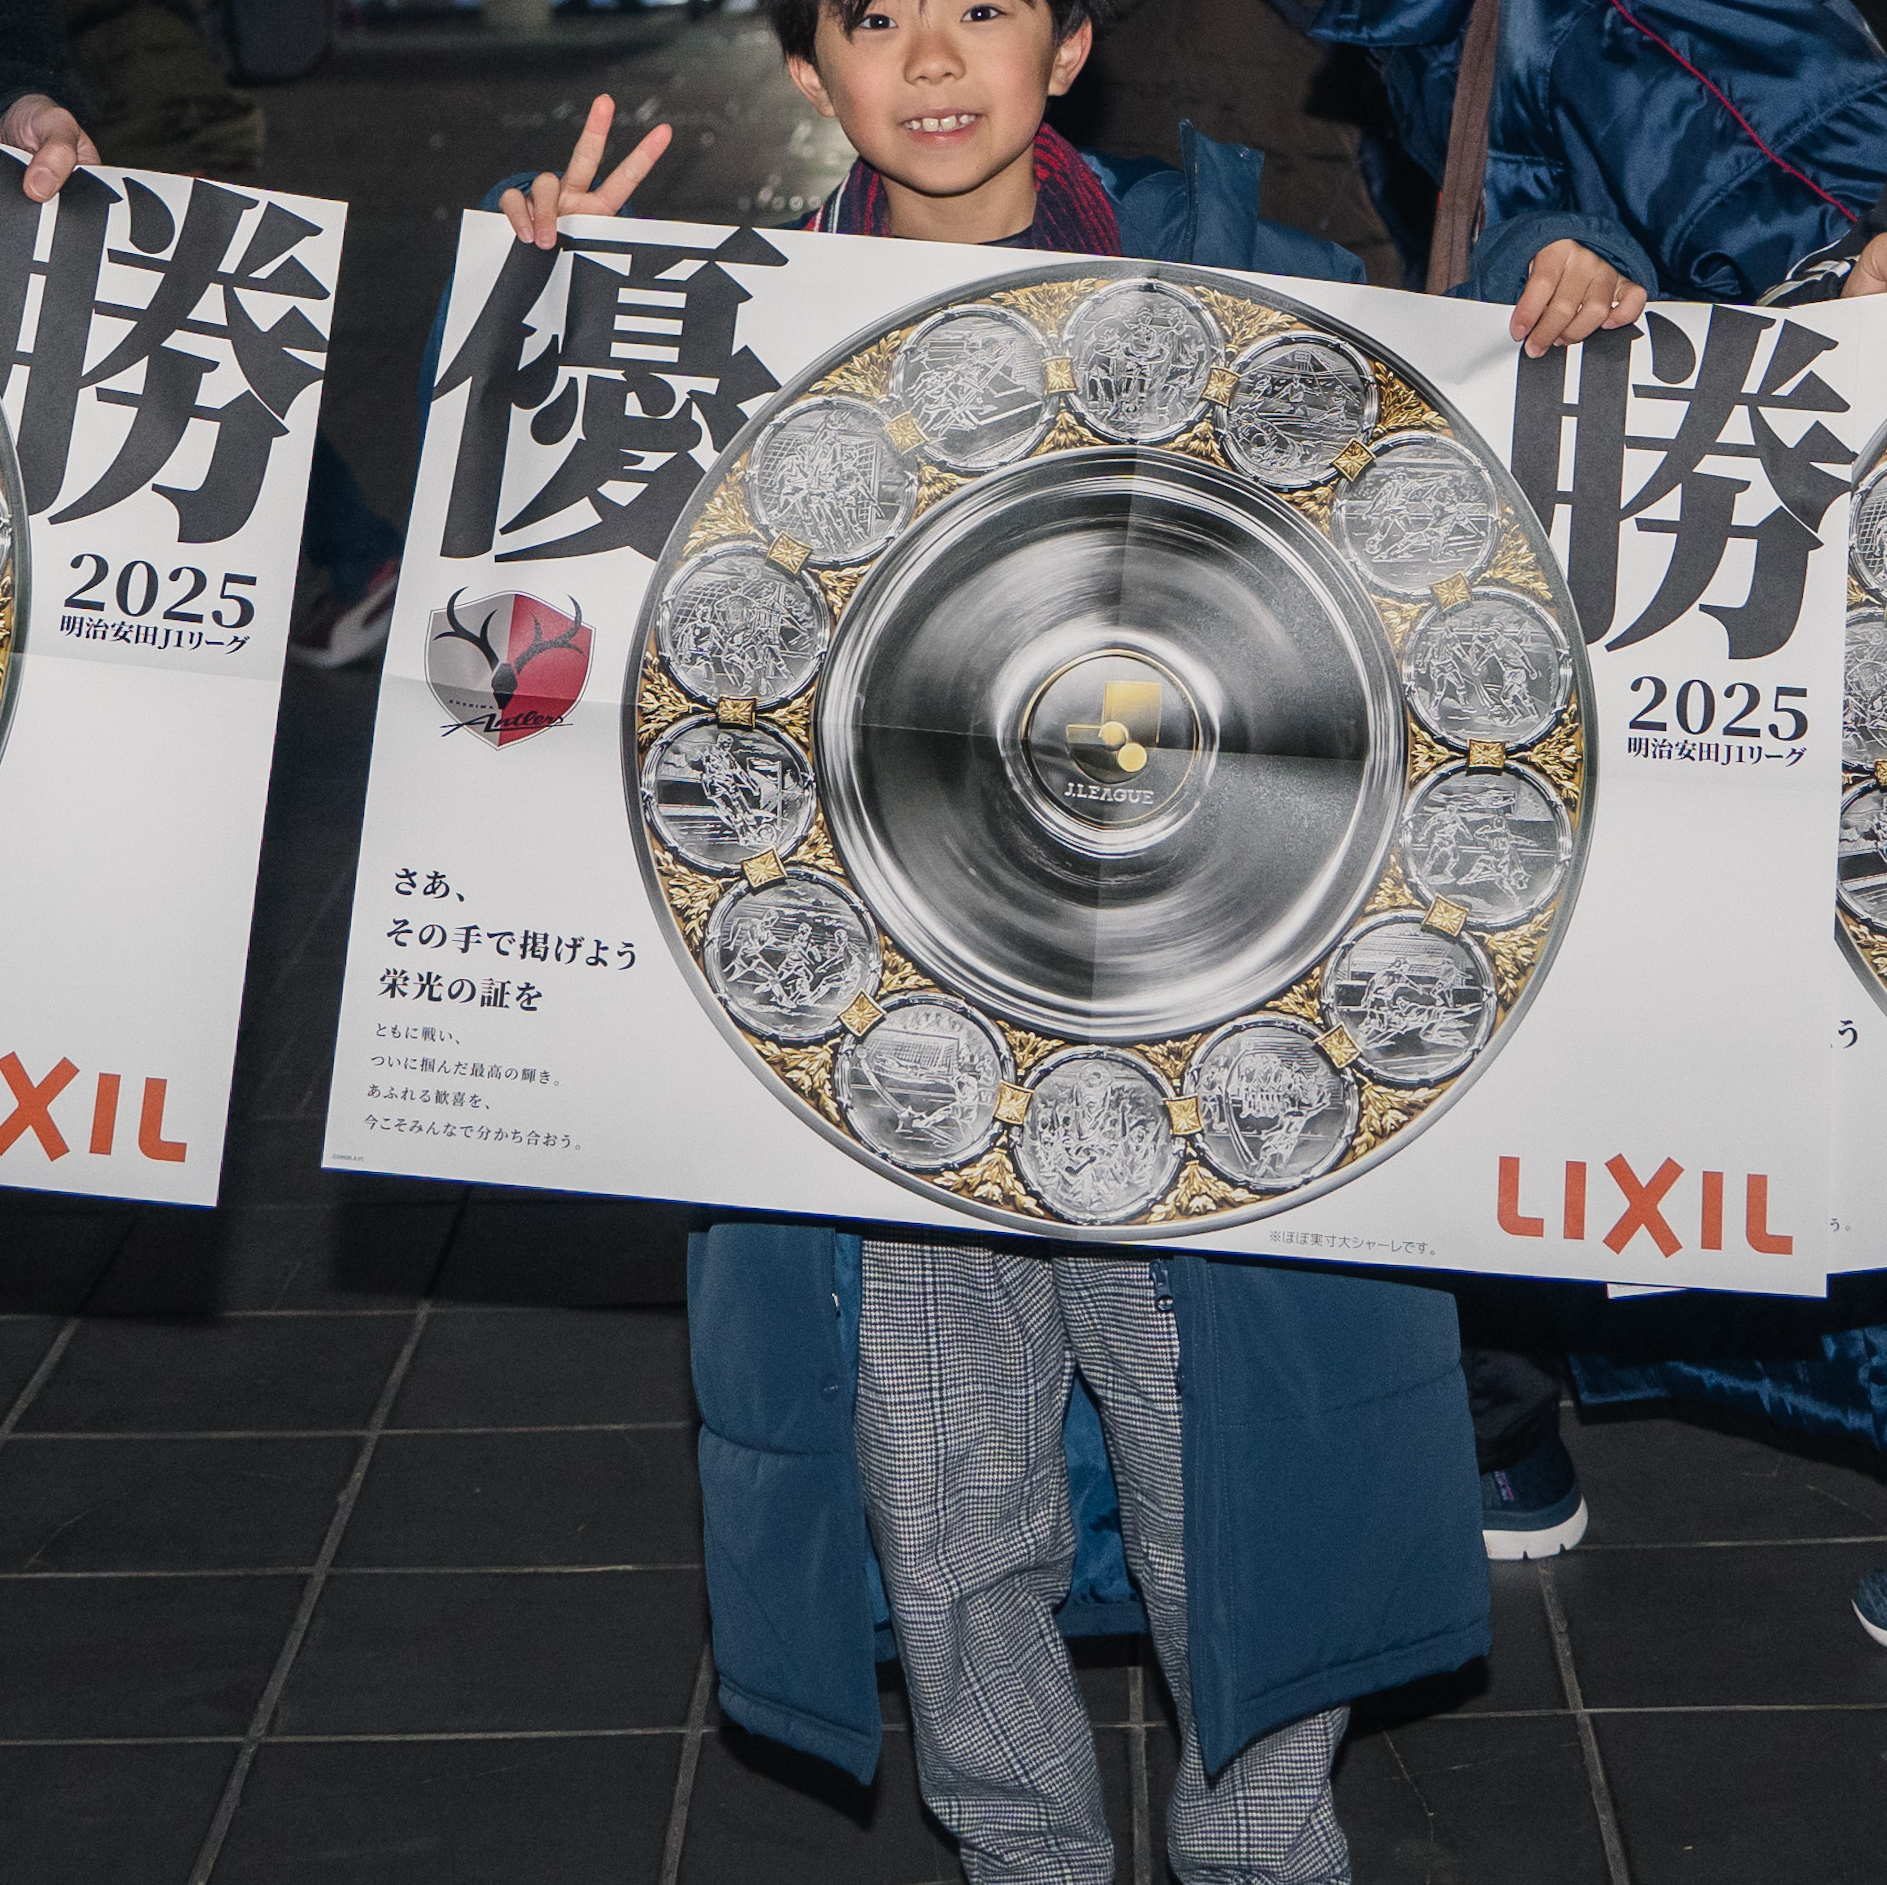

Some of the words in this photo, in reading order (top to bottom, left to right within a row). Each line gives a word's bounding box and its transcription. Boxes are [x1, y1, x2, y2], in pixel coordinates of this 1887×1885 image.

[432, 226, 790, 564] 優
[63, 552, 258, 629] 2025
[59, 614, 251, 655] 明治安田J1リーグ
[439, 710, 574, 738] Antlers
[1628, 675, 1809, 742] 2025
[1626, 736, 1808, 768] 明治安田J1リーグ
[1063, 781, 1155, 806] J.LEAGUE
[394, 867, 465, 903] さあ、
[385, 917, 638, 971] その手で掲げよう
[377, 967, 544, 1013] 栄光の証を
[375, 1022, 462, 1046] ともに戦い、
[366, 1083, 491, 1110] あふれる歓喜を、
[363, 1114, 583, 1152] 今こそみんなで分かち合おう。
[1496, 1153, 1795, 1260] LIXIL
[1269, 1229, 1436, 1257] ※ほぼ実寸大シャーレです。
